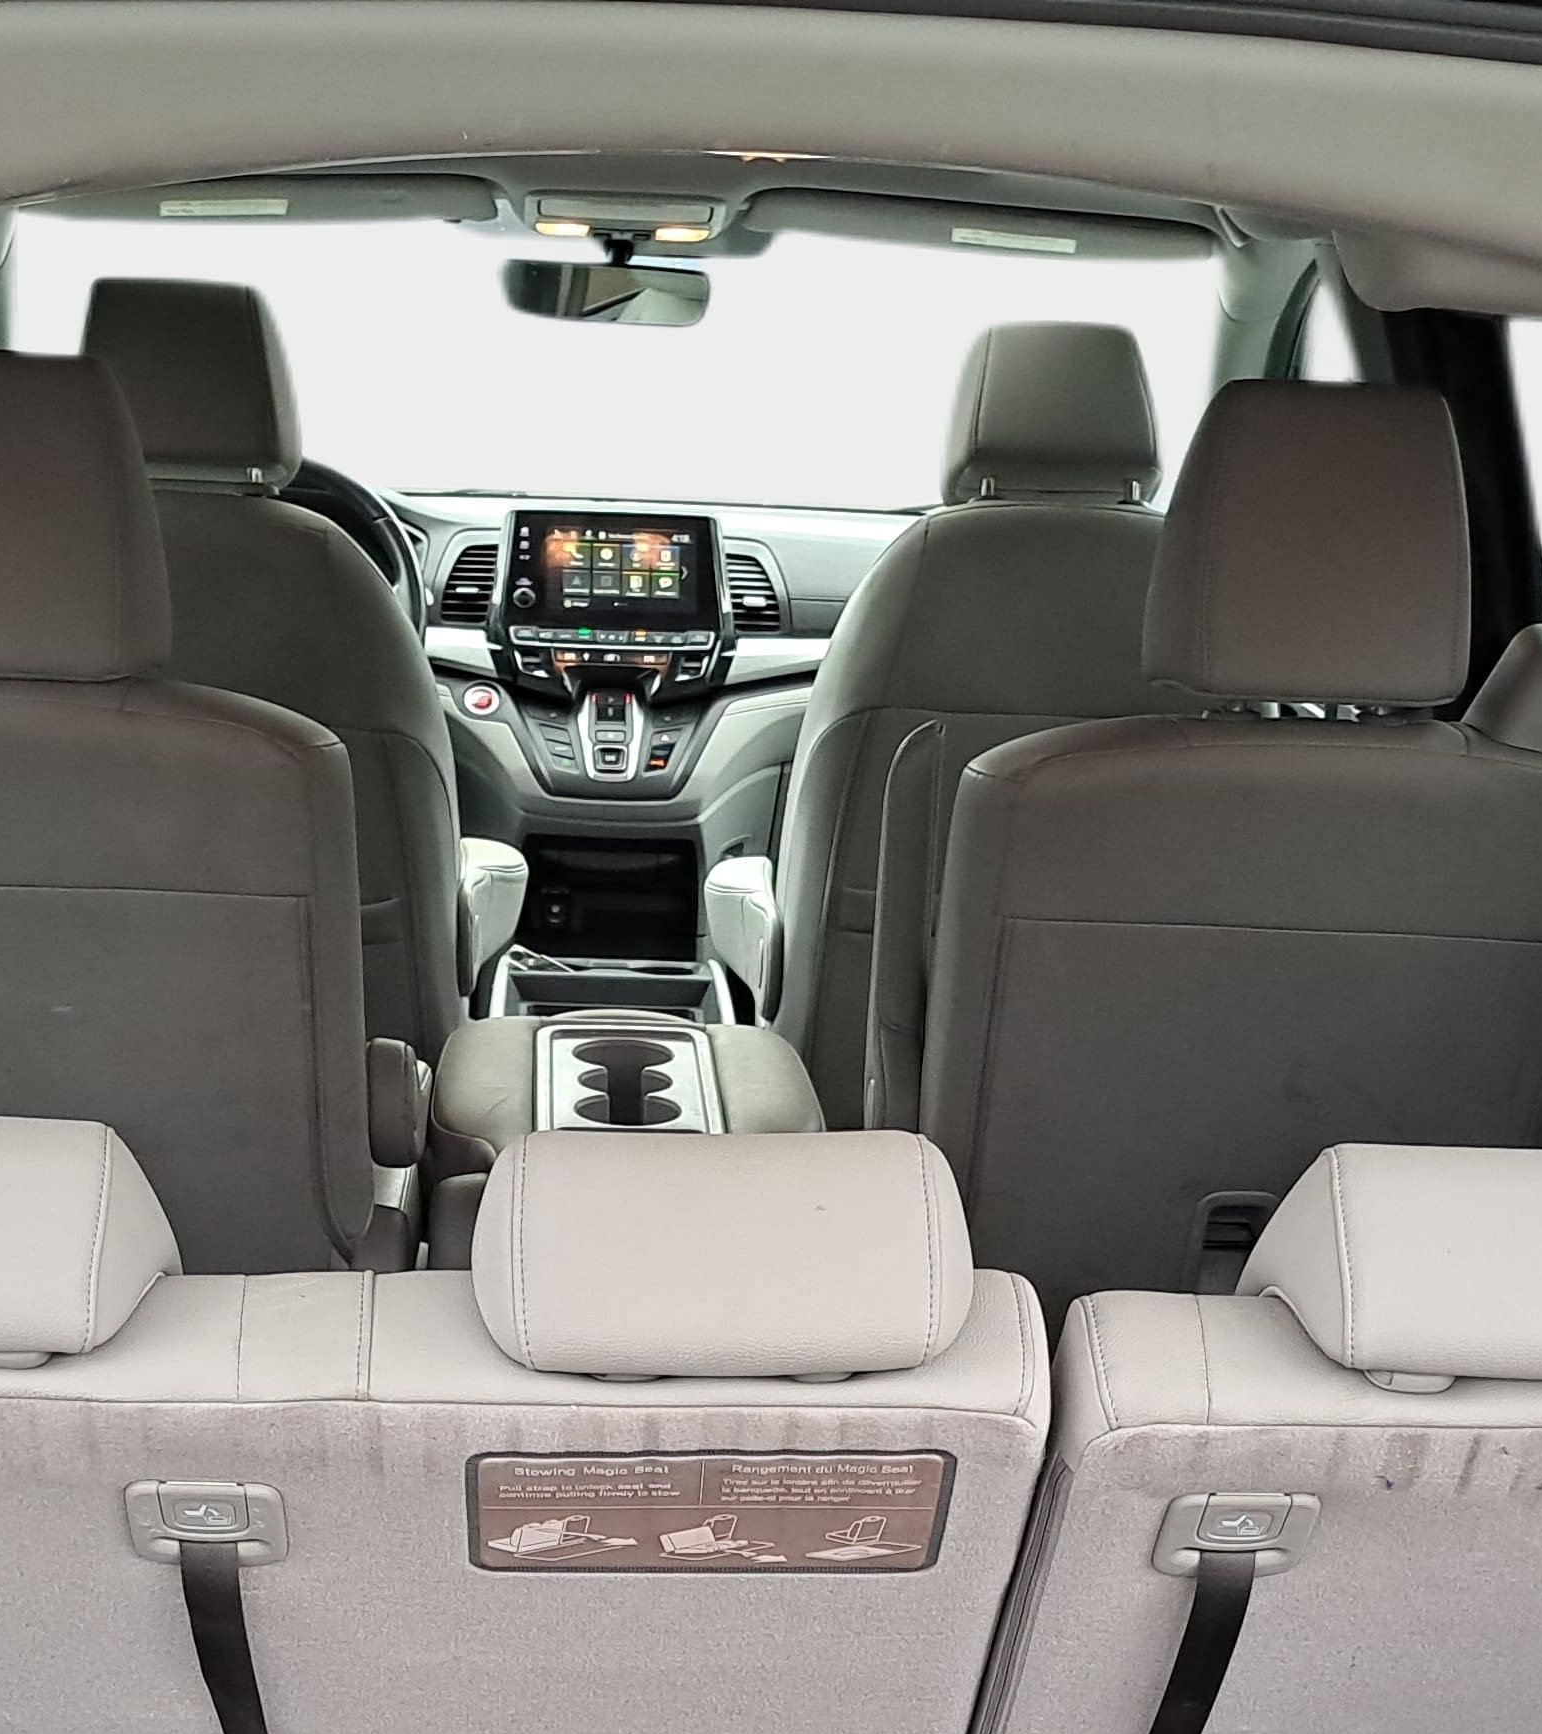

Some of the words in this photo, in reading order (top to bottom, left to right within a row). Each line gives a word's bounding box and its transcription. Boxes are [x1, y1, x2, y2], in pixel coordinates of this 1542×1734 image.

[515, 1467, 575, 1477] Stowing
[584, 1466, 627, 1476] Magic
[635, 1465, 669, 1474] Seat
[732, 1464, 811, 1475] Rangement
[816, 1465, 832, 1474] du
[837, 1464, 877, 1474] Magic
[882, 1465, 914, 1474] Seat
